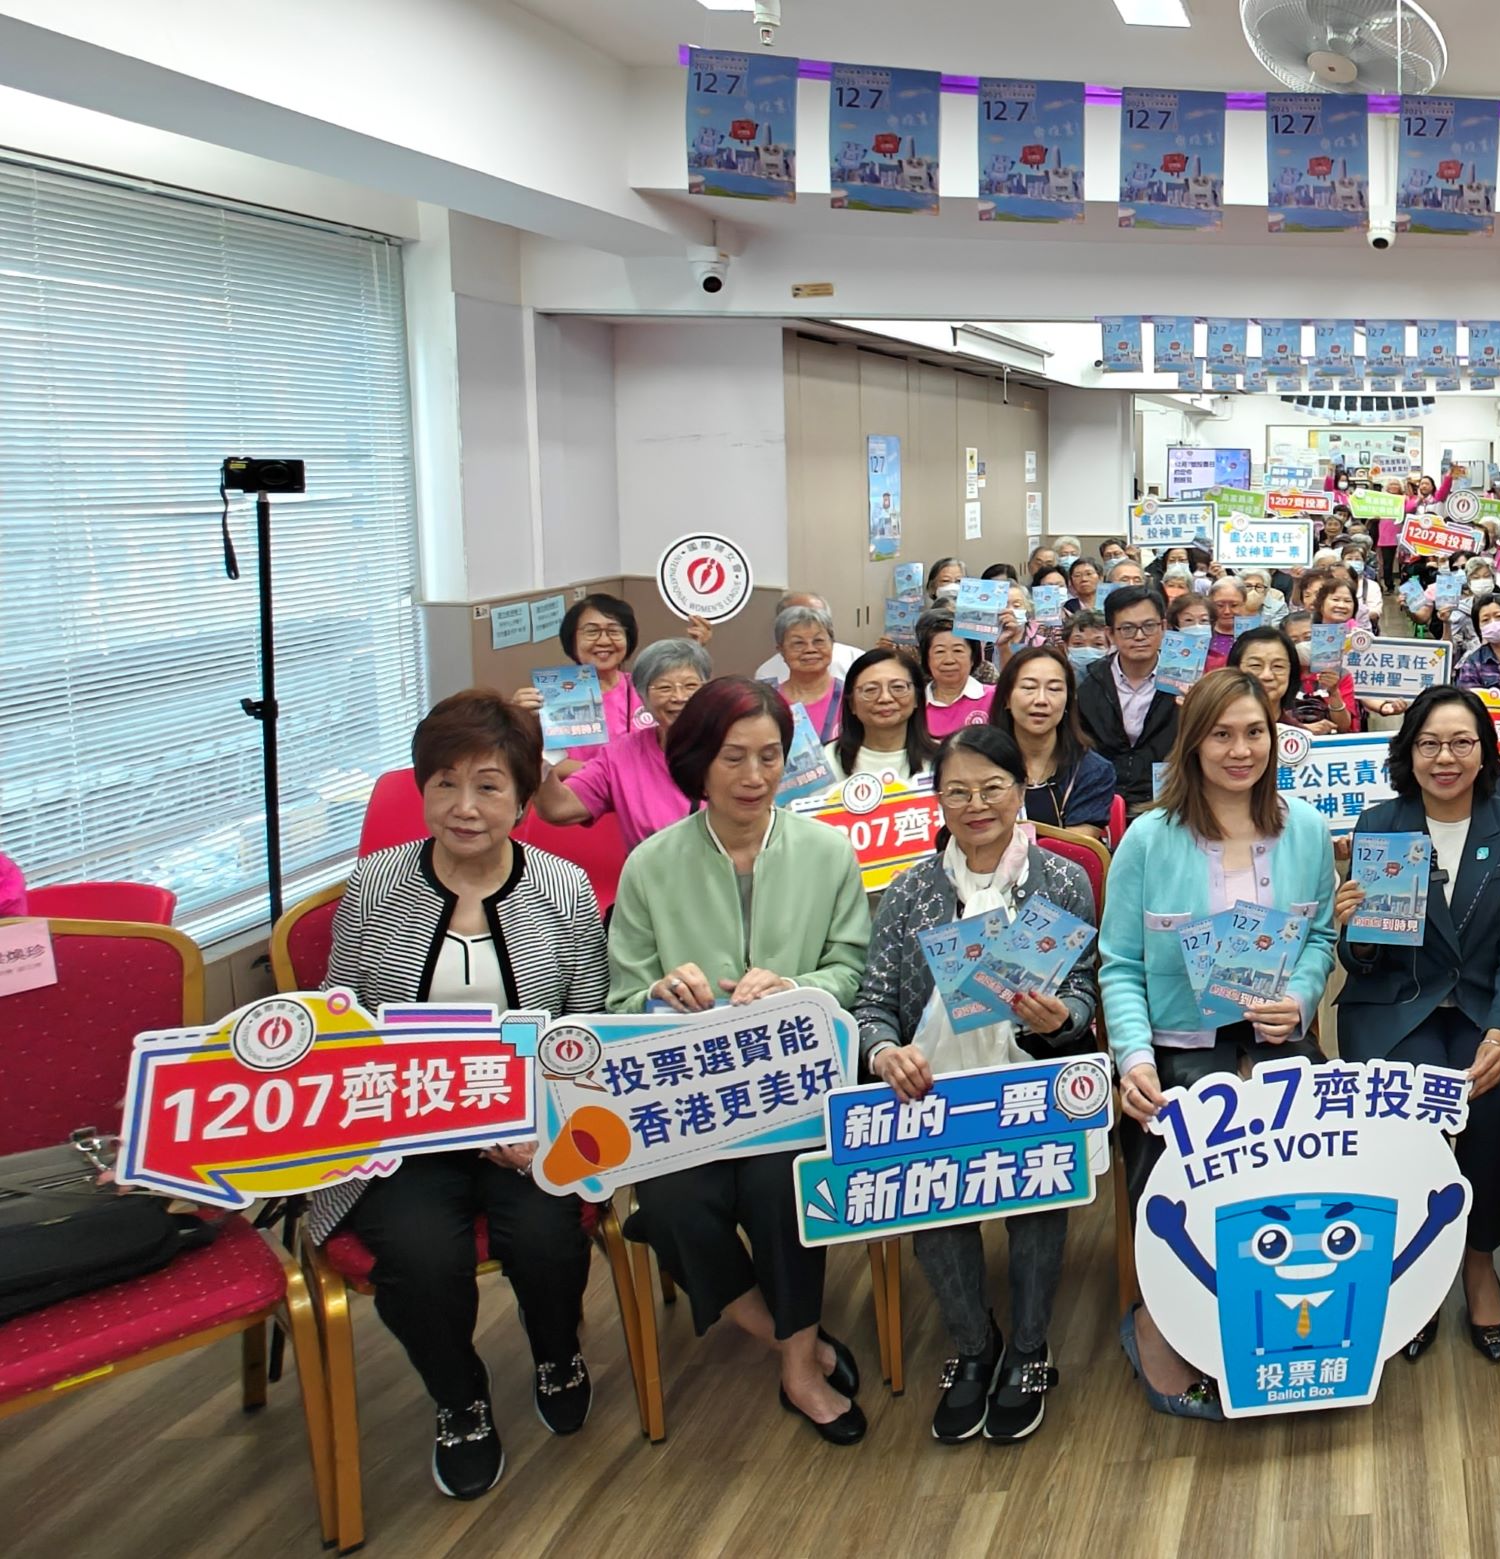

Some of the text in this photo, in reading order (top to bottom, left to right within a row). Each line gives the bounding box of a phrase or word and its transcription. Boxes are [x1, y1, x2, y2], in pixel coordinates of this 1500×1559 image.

[1408, 526, 1475, 551] 1207齊投票
[1347, 651, 1428, 670] 盡公民責任
[1354, 669, 1434, 688] 投神聖一票
[1298, 791, 1387, 819] 神聖一
[1381, 918, 1418, 932] 到時見
[603, 1016, 819, 1095] 投票選賢能
[163, 1053, 512, 1144] 1207齊投票
[630, 1062, 842, 1149] 香港更美好
[844, 1080, 1048, 1149] 新的一票
[1157, 1067, 1302, 1158] 12.7
[1314, 1068, 1466, 1127] 齊投票
[1184, 1130, 1358, 1190] LET'S VOTE
[1256, 1357, 1348, 1391] 投票箱
[1267, 1386, 1335, 1402] Ballot Box
